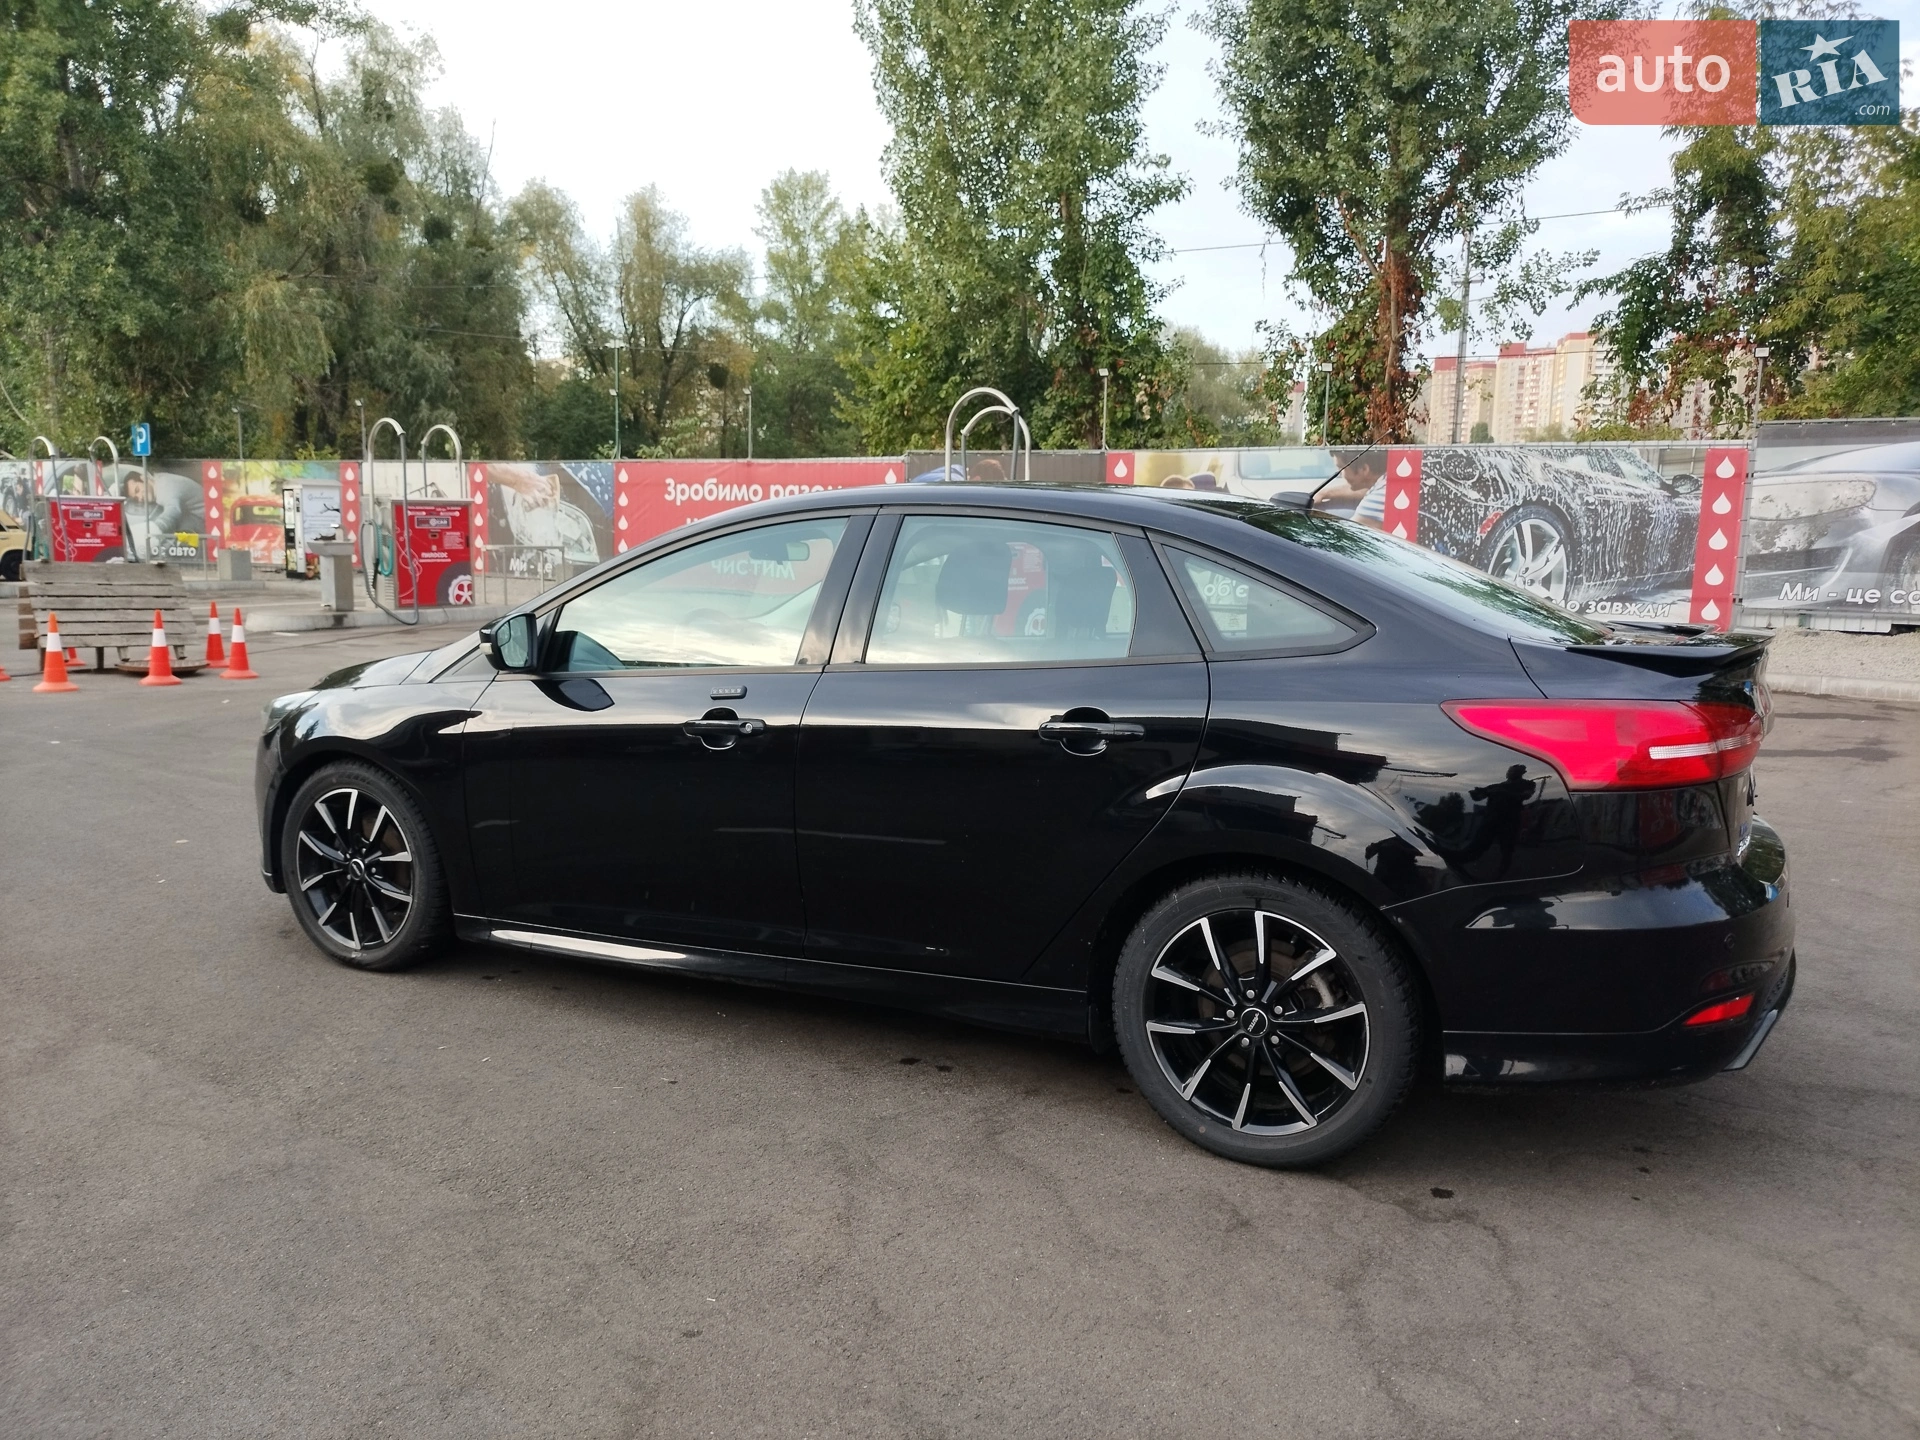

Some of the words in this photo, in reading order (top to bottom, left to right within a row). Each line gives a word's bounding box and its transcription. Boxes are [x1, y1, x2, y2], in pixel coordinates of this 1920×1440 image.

[136, 427, 147, 453] P
[664, 477, 763, 505] Зробимо
[168, 545, 197, 558] авто
[509, 557, 528, 572] Ми
[1778, 582, 1820, 602] Ми
[1845, 587, 1881, 605] це
[1585, 599, 1671, 619] завжди
